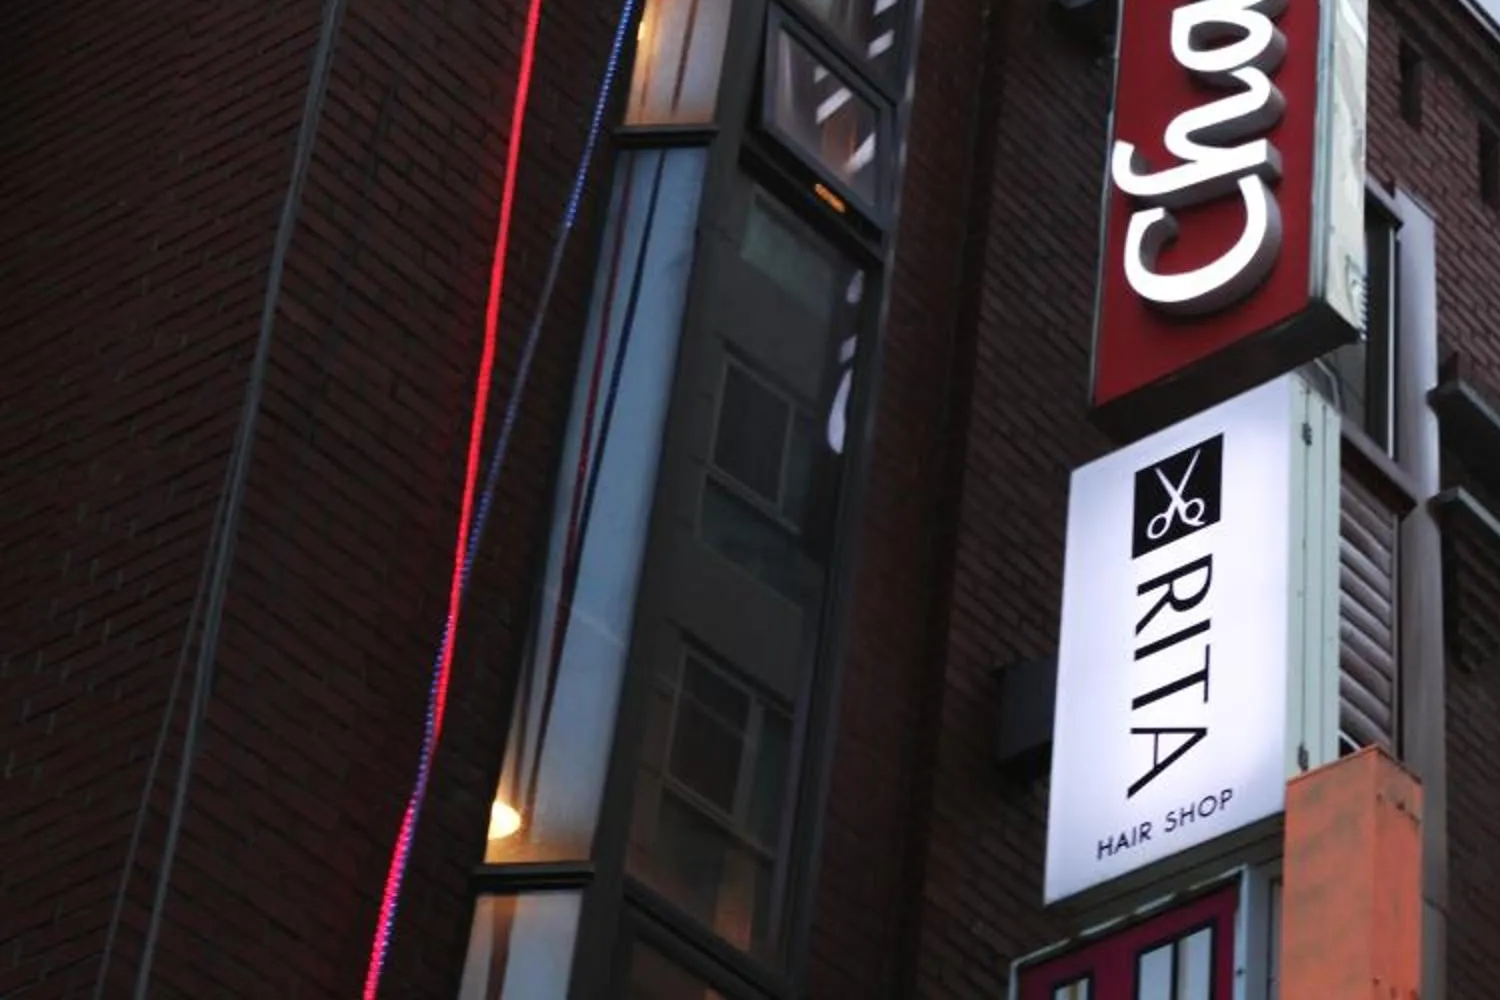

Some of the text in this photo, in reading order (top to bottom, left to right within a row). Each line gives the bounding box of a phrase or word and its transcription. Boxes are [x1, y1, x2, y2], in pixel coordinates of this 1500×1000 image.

[1126, 553, 1213, 799] RITA
[1097, 788, 1234, 860] HAIR SHOP
